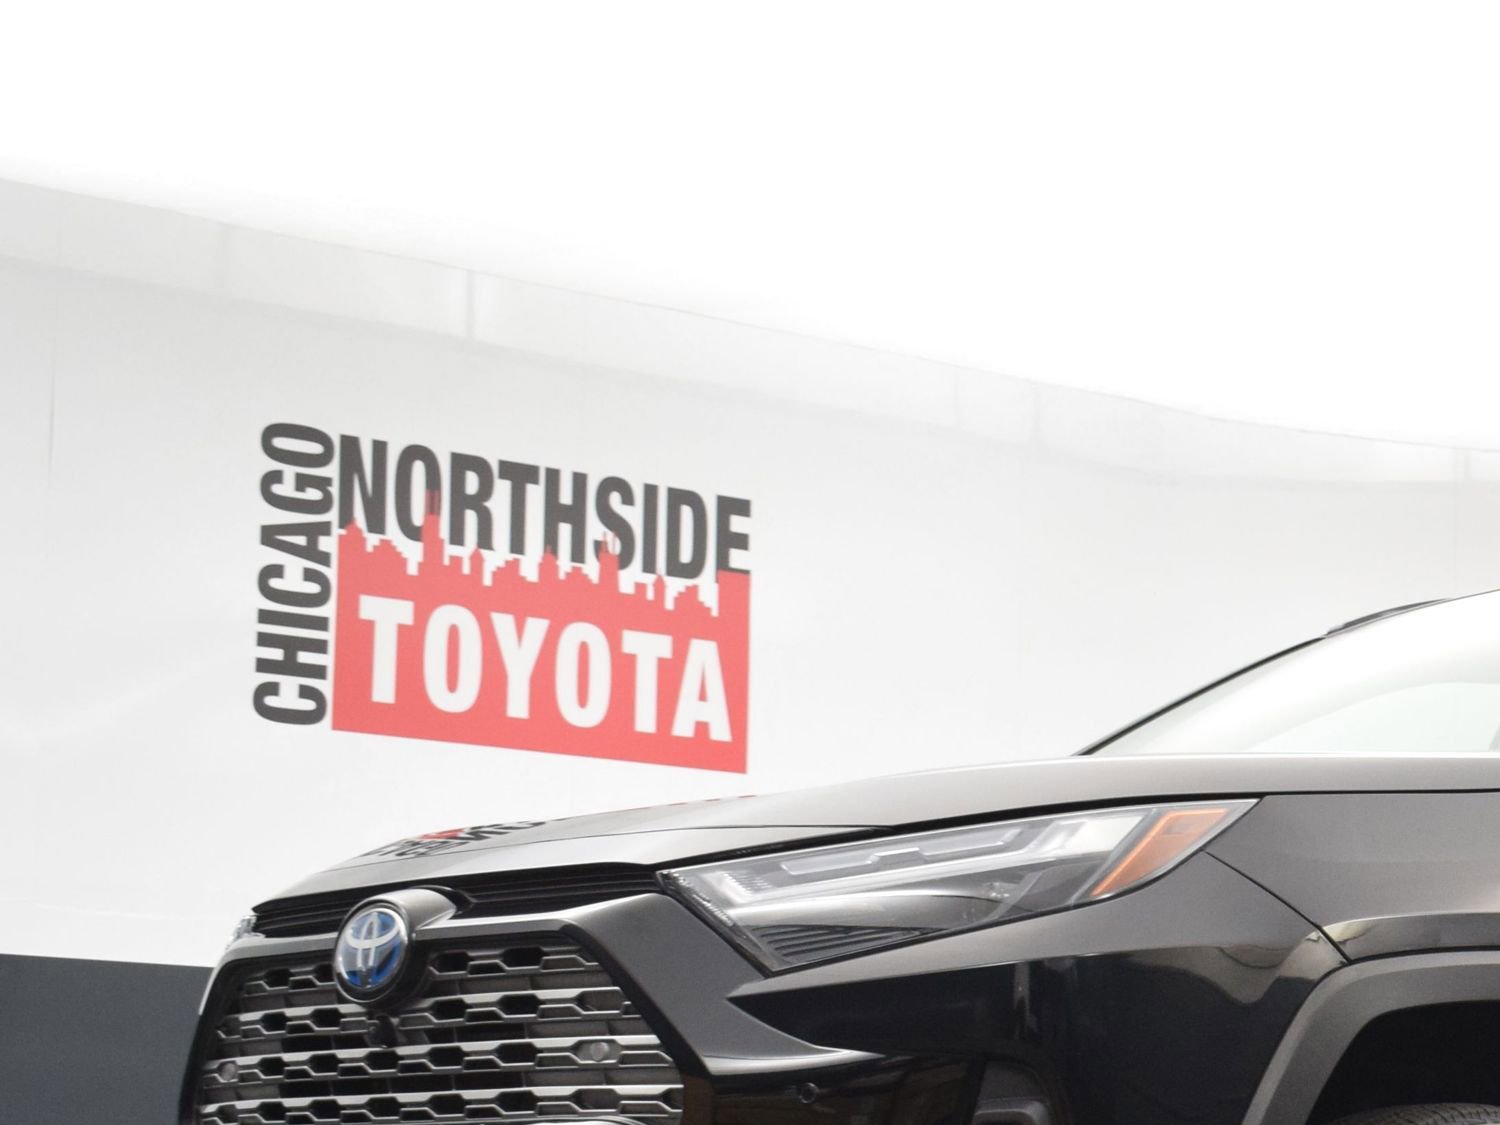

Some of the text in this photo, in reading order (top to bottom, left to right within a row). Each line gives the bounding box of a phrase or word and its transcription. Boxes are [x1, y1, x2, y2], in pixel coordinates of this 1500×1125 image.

[252, 421, 336, 727] CHICAGO
[338, 433, 752, 584] NORTHSIDE
[357, 594, 733, 742] TOYOTA
